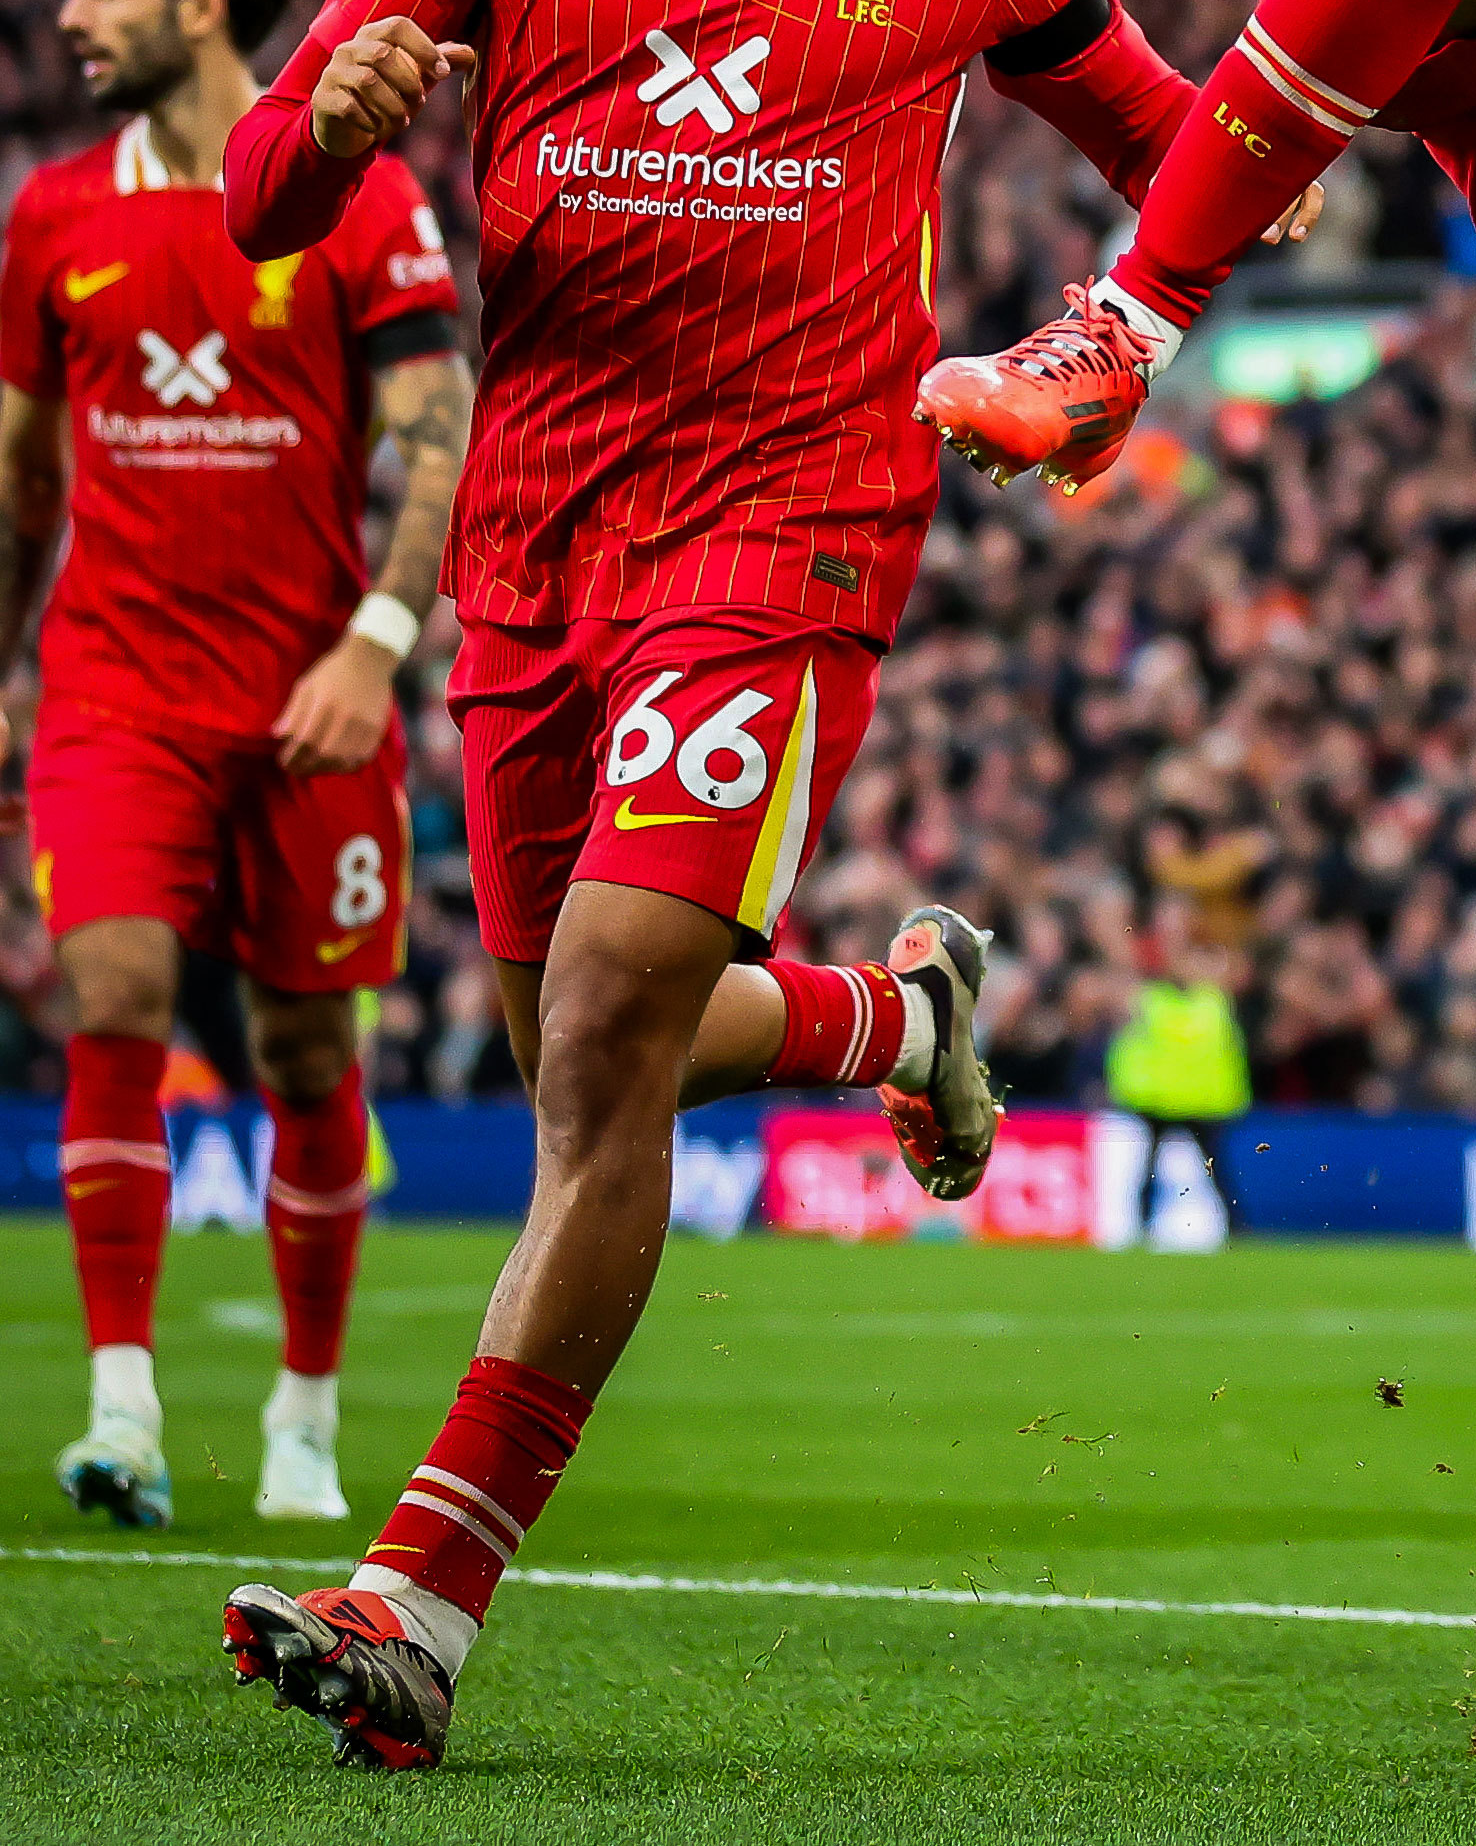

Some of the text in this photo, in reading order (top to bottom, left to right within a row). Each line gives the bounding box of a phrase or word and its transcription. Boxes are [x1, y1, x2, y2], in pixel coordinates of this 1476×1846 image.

[1213, 101, 1272, 158] LFC
[535, 132, 842, 190] futuremakers
[558, 190, 803, 223] by Standard Chartered
[605, 669, 774, 810] 66
[331, 833, 388, 930] 8
